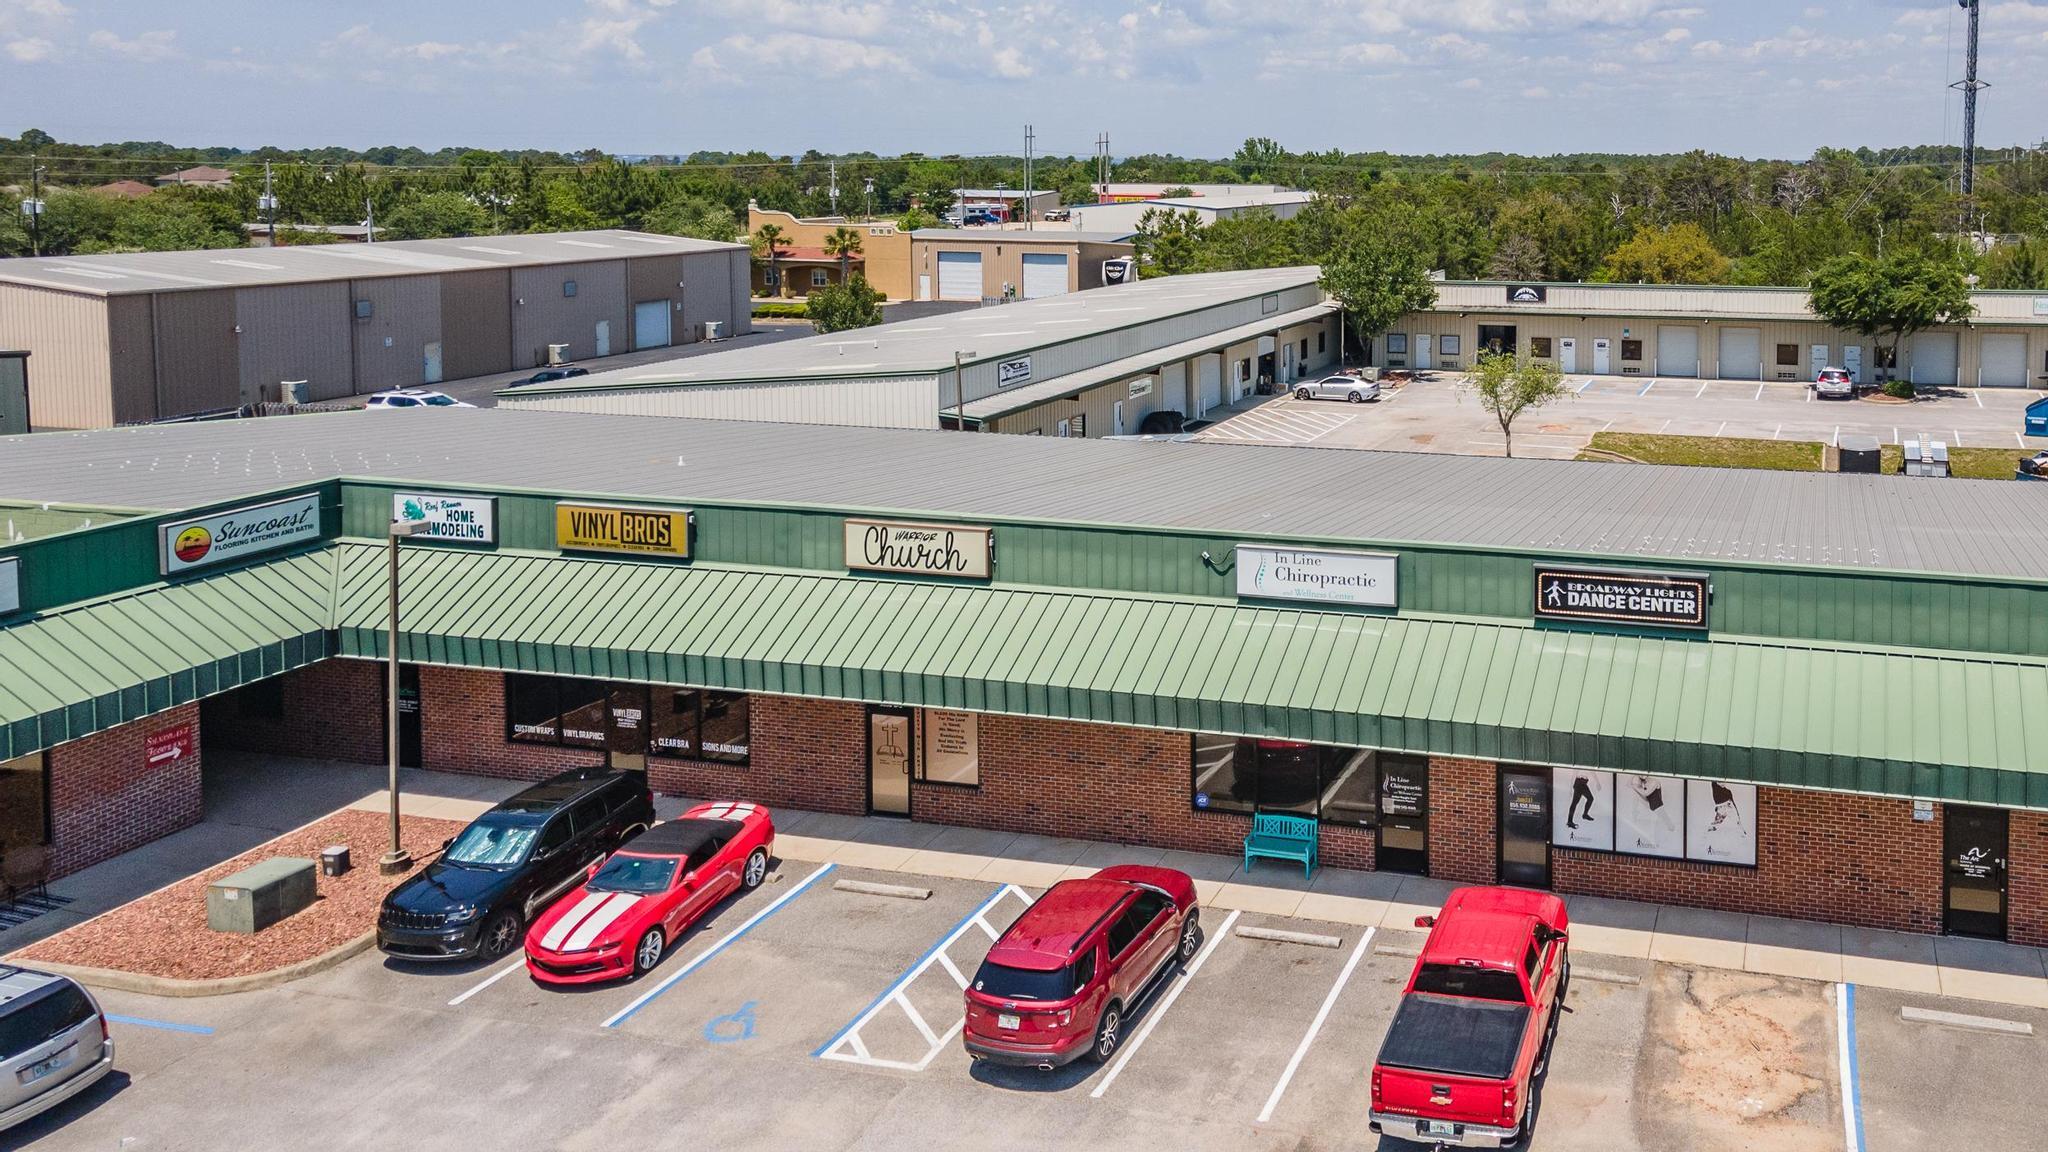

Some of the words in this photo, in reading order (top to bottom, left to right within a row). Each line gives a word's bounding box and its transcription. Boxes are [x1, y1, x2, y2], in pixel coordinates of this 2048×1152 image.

[446, 510, 474, 522] HOME
[215, 504, 314, 543] Suncoast
[571, 511, 618, 540] VINYL
[622, 514, 669, 544] BROS
[215, 538, 249, 552] FLOORING
[251, 532, 280, 544] KITCHEN
[281, 528, 294, 537] AND
[296, 524, 314, 533] BATH
[895, 531, 938, 542] WARRIOR
[864, 526, 967, 571] Church
[1275, 552, 1287, 564] In
[1292, 553, 1321, 566] Line
[1275, 566, 1376, 589] Chiropractic
[1295, 588, 1326, 599] Wellness
[1328, 591, 1354, 601] Center
[1567, 582, 1643, 596] BROADWAY
[1645, 588, 1695, 599] LIGHTS
[1567, 592, 1626, 610] DANCE
[1628, 597, 1696, 614] CENTER
[514, 724, 537, 734] CUSTOM
[537, 725, 555, 736] WRAPS
[563, 728, 579, 739] VINYL
[579, 730, 605, 741] GRAPHICS
[658, 738, 676, 748] CLEAR
[676, 739, 690, 749] BRA
[702, 742, 719, 752] SIGNS
[720, 744, 732, 753] AND
[732, 745, 748, 755] MORE
